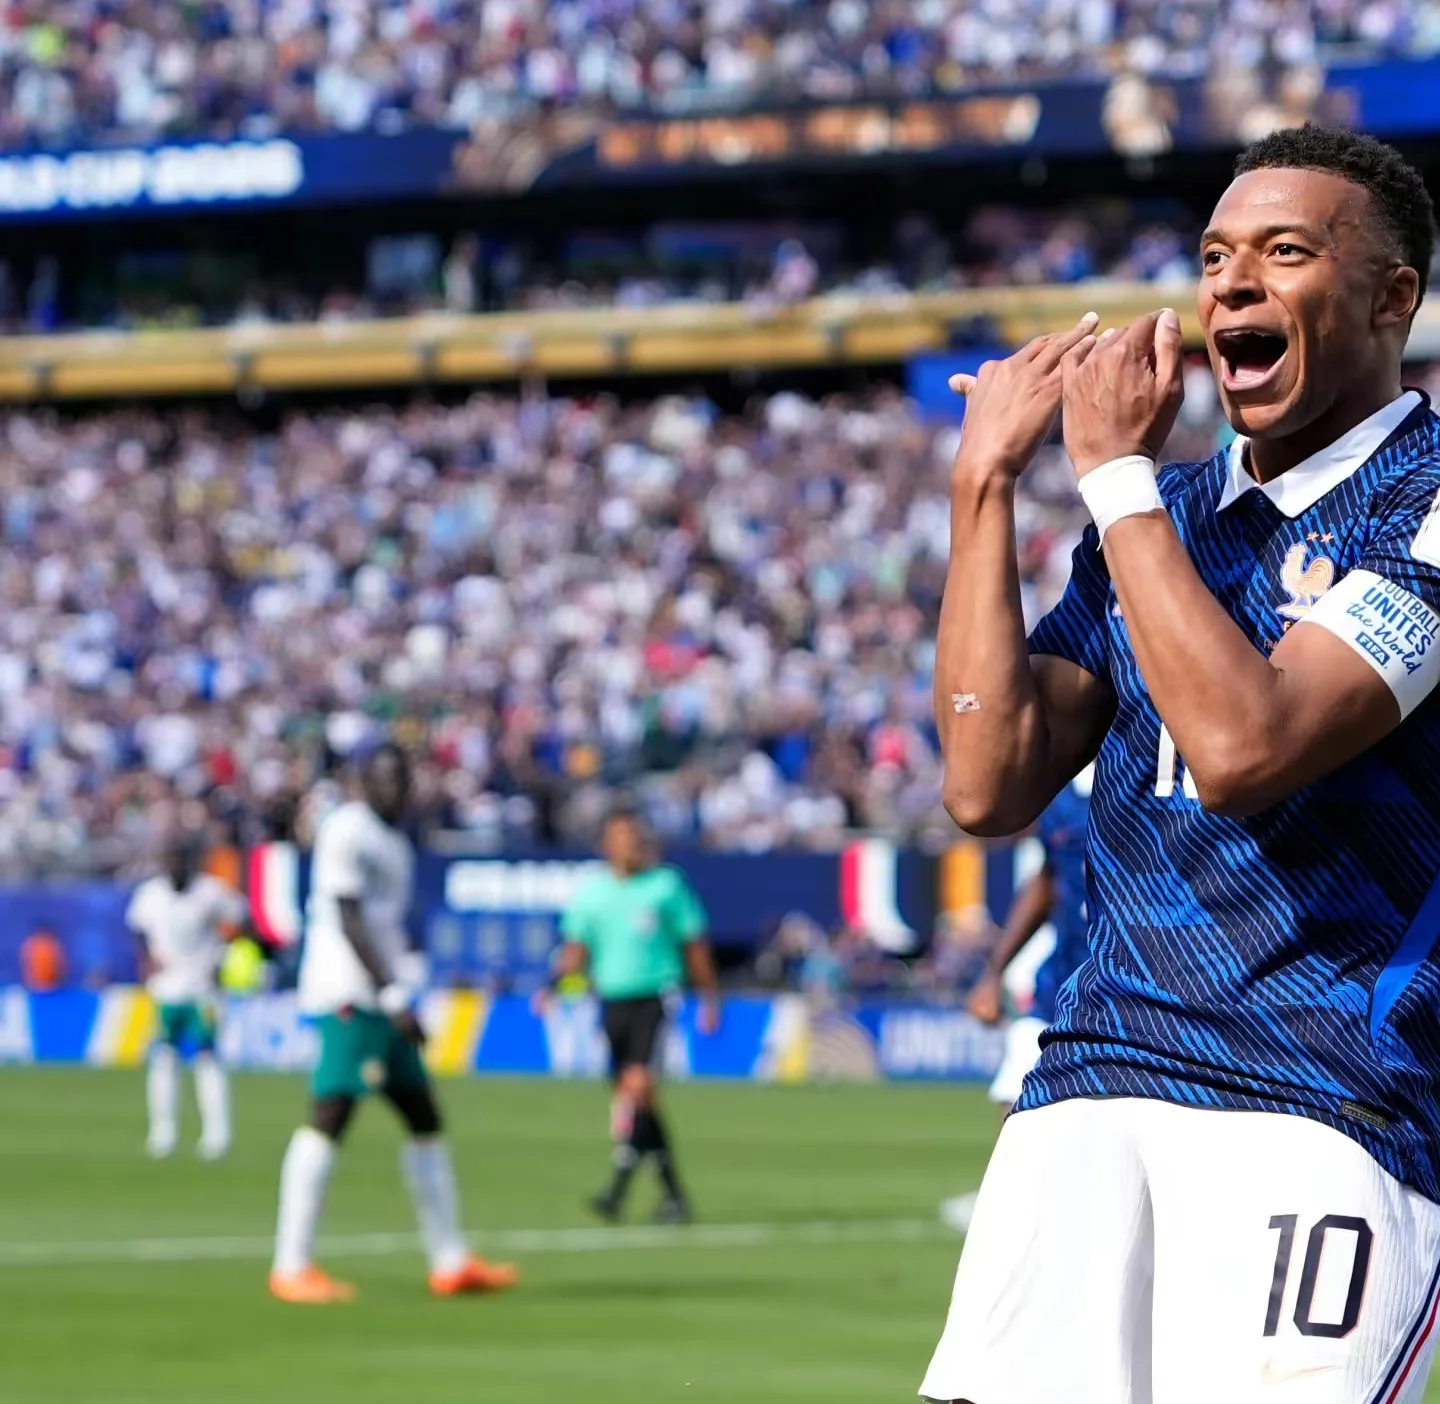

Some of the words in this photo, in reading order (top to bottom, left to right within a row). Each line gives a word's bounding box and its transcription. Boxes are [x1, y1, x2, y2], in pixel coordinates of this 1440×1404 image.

[1346, 601, 1374, 627] the
[1374, 623, 1422, 675] World
[1362, 586, 1432, 656] UNITES
[1377, 578, 1440, 640] FOOTBALL
[1356, 632, 1389, 666] FIFA
[1263, 1213, 1374, 1339] 10
